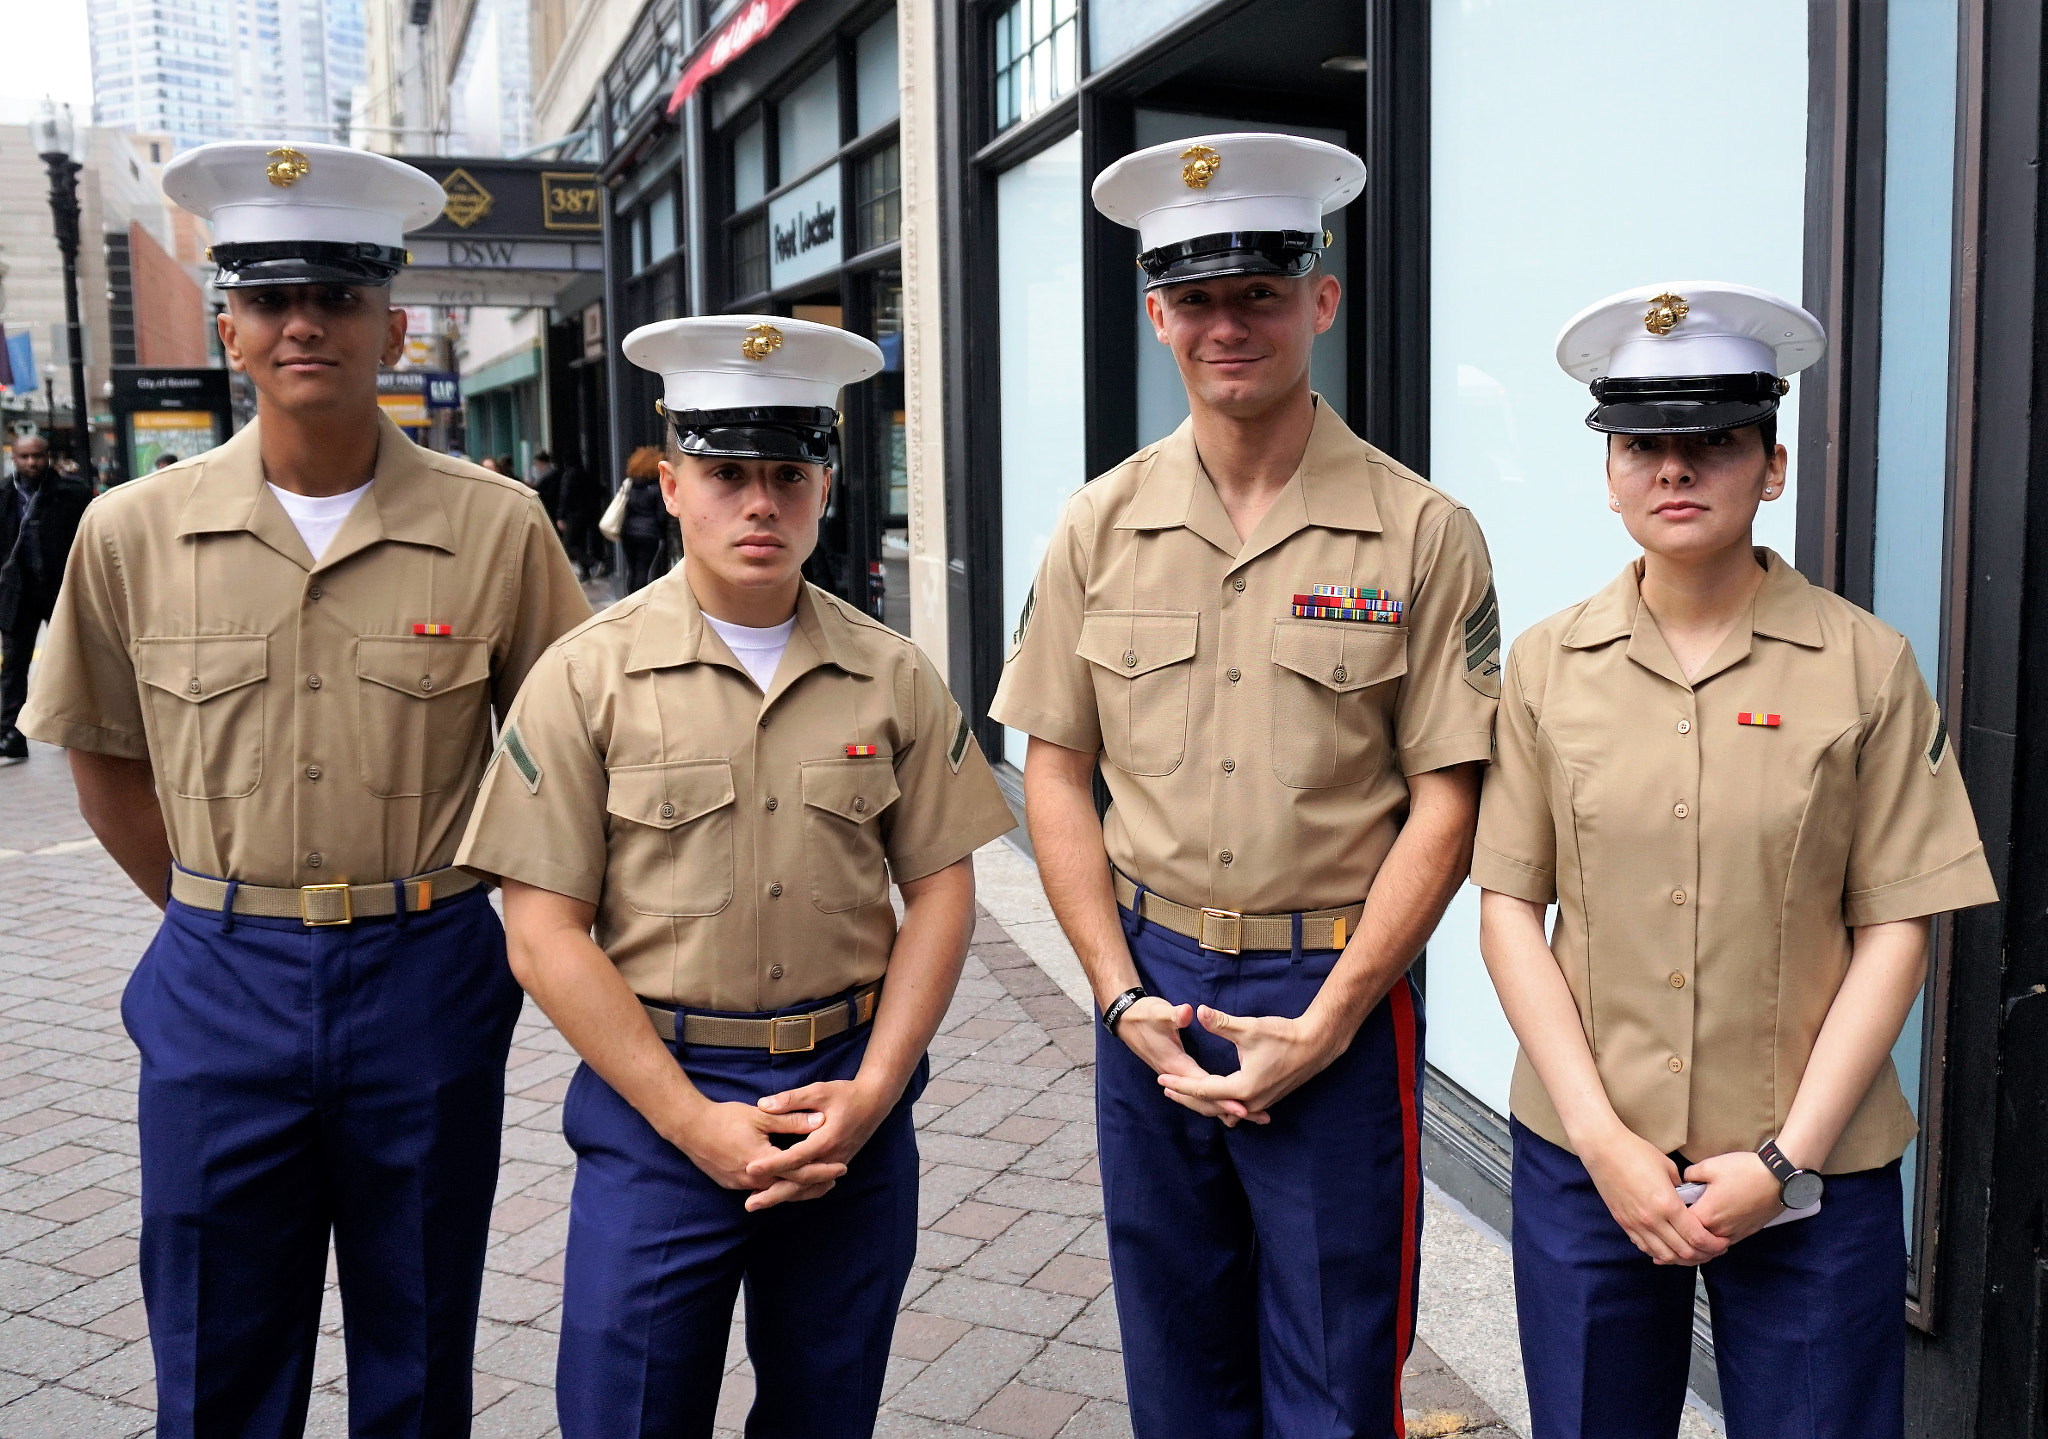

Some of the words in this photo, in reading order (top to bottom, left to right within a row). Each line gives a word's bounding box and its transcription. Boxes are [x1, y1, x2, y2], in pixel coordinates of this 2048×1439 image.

[551, 187, 596, 214] 387
[447, 241, 516, 265] DSW
[137, 377, 155, 389] City
[1107, 996, 1129, 1024] MEMORY
